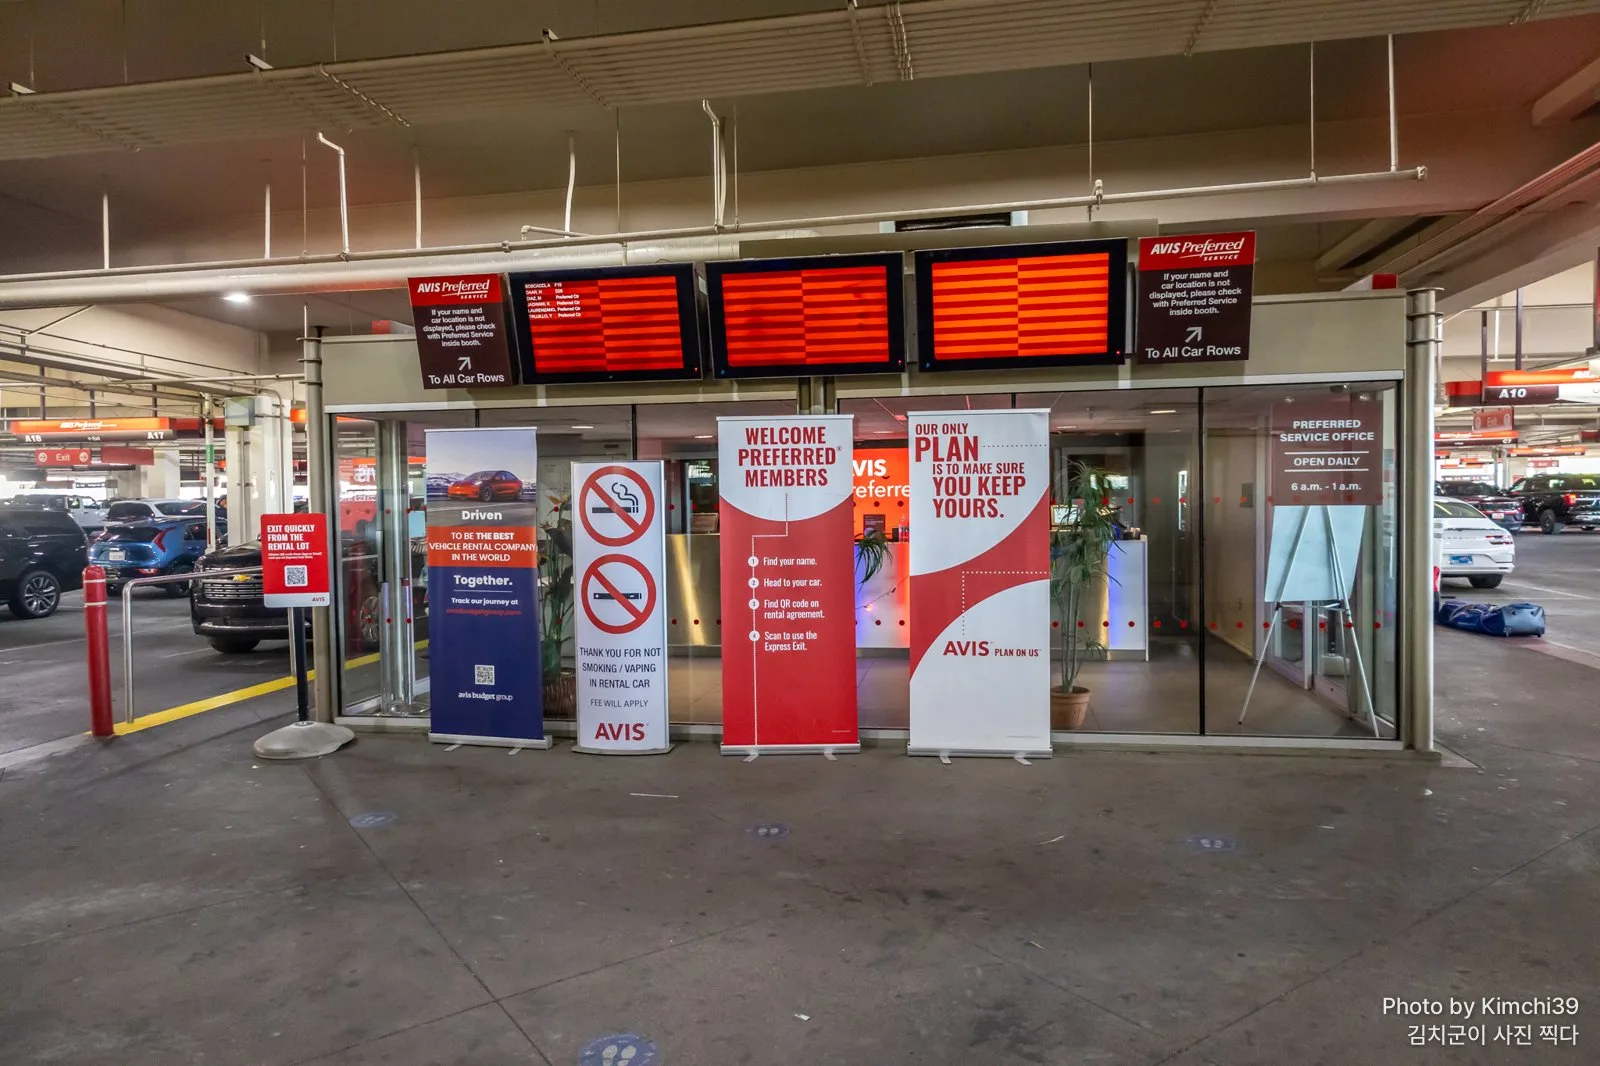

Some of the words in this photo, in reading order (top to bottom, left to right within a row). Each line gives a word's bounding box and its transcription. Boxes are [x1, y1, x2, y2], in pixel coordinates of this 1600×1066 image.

[1150, 242, 1181, 255] AVIS
[1182, 237, 1245, 257] Preferred
[1164, 273, 1169, 281] If
[1170, 273, 1188, 282] your
[1213, 270, 1229, 278] and
[417, 282, 441, 293] AVIS
[441, 279, 490, 296] Preferred
[1175, 280, 1207, 289] location
[1217, 279, 1230, 287] not
[1149, 290, 1188, 301] displayed,
[1190, 290, 1216, 299] please
[1217, 288, 1242, 296] check
[1153, 299, 1169, 308] with
[1171, 298, 1206, 307] Preferred
[1208, 297, 1237, 306] Service
[437, 309, 451, 317] your
[1169, 308, 1193, 316] inside
[1194, 307, 1220, 315] booth.
[423, 325, 454, 333] displayed,
[456, 324, 475, 332] please
[1145, 348, 1160, 359] To
[1163, 347, 1178, 358] All
[1181, 346, 1203, 357] Car
[1207, 345, 1241, 356] Rows
[428, 375, 440, 384] To
[443, 374, 456, 383] All
[458, 374, 475, 383] Car
[477, 373, 504, 382] Rows
[1499, 388, 1527, 398] A10
[915, 424, 938, 435] OUR
[942, 423, 968, 435] ONLY
[1293, 420, 1361, 429] PREFERRED
[746, 427, 826, 445] WELCOME
[1280, 433, 1330, 442] SERVICE
[1332, 432, 1374, 441] OFFICE
[915, 436, 978, 462] PLAN
[56, 453, 70, 462] Exit
[1294, 458, 1324, 466] OPEN
[1328, 457, 1360, 465] DAILY
[852, 459, 887, 477] VIS
[932, 463, 942, 475] IS
[946, 463, 959, 475] TO
[963, 463, 992, 474] MAKE
[996, 463, 1024, 474] SURE
[745, 469, 828, 487] MEMBERS
[852, 480, 910, 498] referre
[933, 476, 971, 496] YOU
[978, 476, 1026, 496] KEEP
[1291, 483, 1298, 491] 6
[933, 498, 1004, 518] YOURS.
[462, 509, 502, 520] Driven
[284, 525, 315, 533] QUICKLY
[451, 532, 462, 540] TO
[268, 542, 295, 550] RENTAL
[296, 542, 309, 550] LOT
[494, 543, 536, 551] COMPANY
[763, 557, 777, 565] Find
[780, 558, 795, 567] your
[454, 575, 513, 588] Together.
[764, 578, 782, 587] Head
[783, 579, 790, 587] to
[792, 579, 808, 588] your
[809, 579, 822, 587] car.
[483, 598, 509, 606] journey
[764, 600, 778, 608] Find
[780, 599, 790, 609] QR
[792, 599, 808, 608] code
[811, 600, 819, 608] on
[764, 610, 785, 619] rental
[787, 610, 825, 620] agreement.
[765, 631, 781, 640] Scan
[783, 632, 790, 640] to
[806, 631, 817, 639] the
[765, 642, 790, 652] Express
[792, 642, 807, 650] Exit.
[943, 641, 990, 656] AVIS
[994, 649, 1014, 657] PLAN
[1016, 649, 1026, 657] ON
[1029, 649, 1039, 657] US
[580, 647, 603, 657] THANK
[605, 648, 621, 658] YOU
[624, 649, 641, 657] FOR
[644, 648, 661, 657] NOT
[582, 663, 617, 673] SMOKING
[624, 664, 656, 672] VAPING
[589, 679, 597, 687] IN
[600, 679, 630, 688] RENTAL
[632, 679, 650, 688] CAR
[472, 692, 495, 700] budget
[595, 722, 645, 740] AVIS
